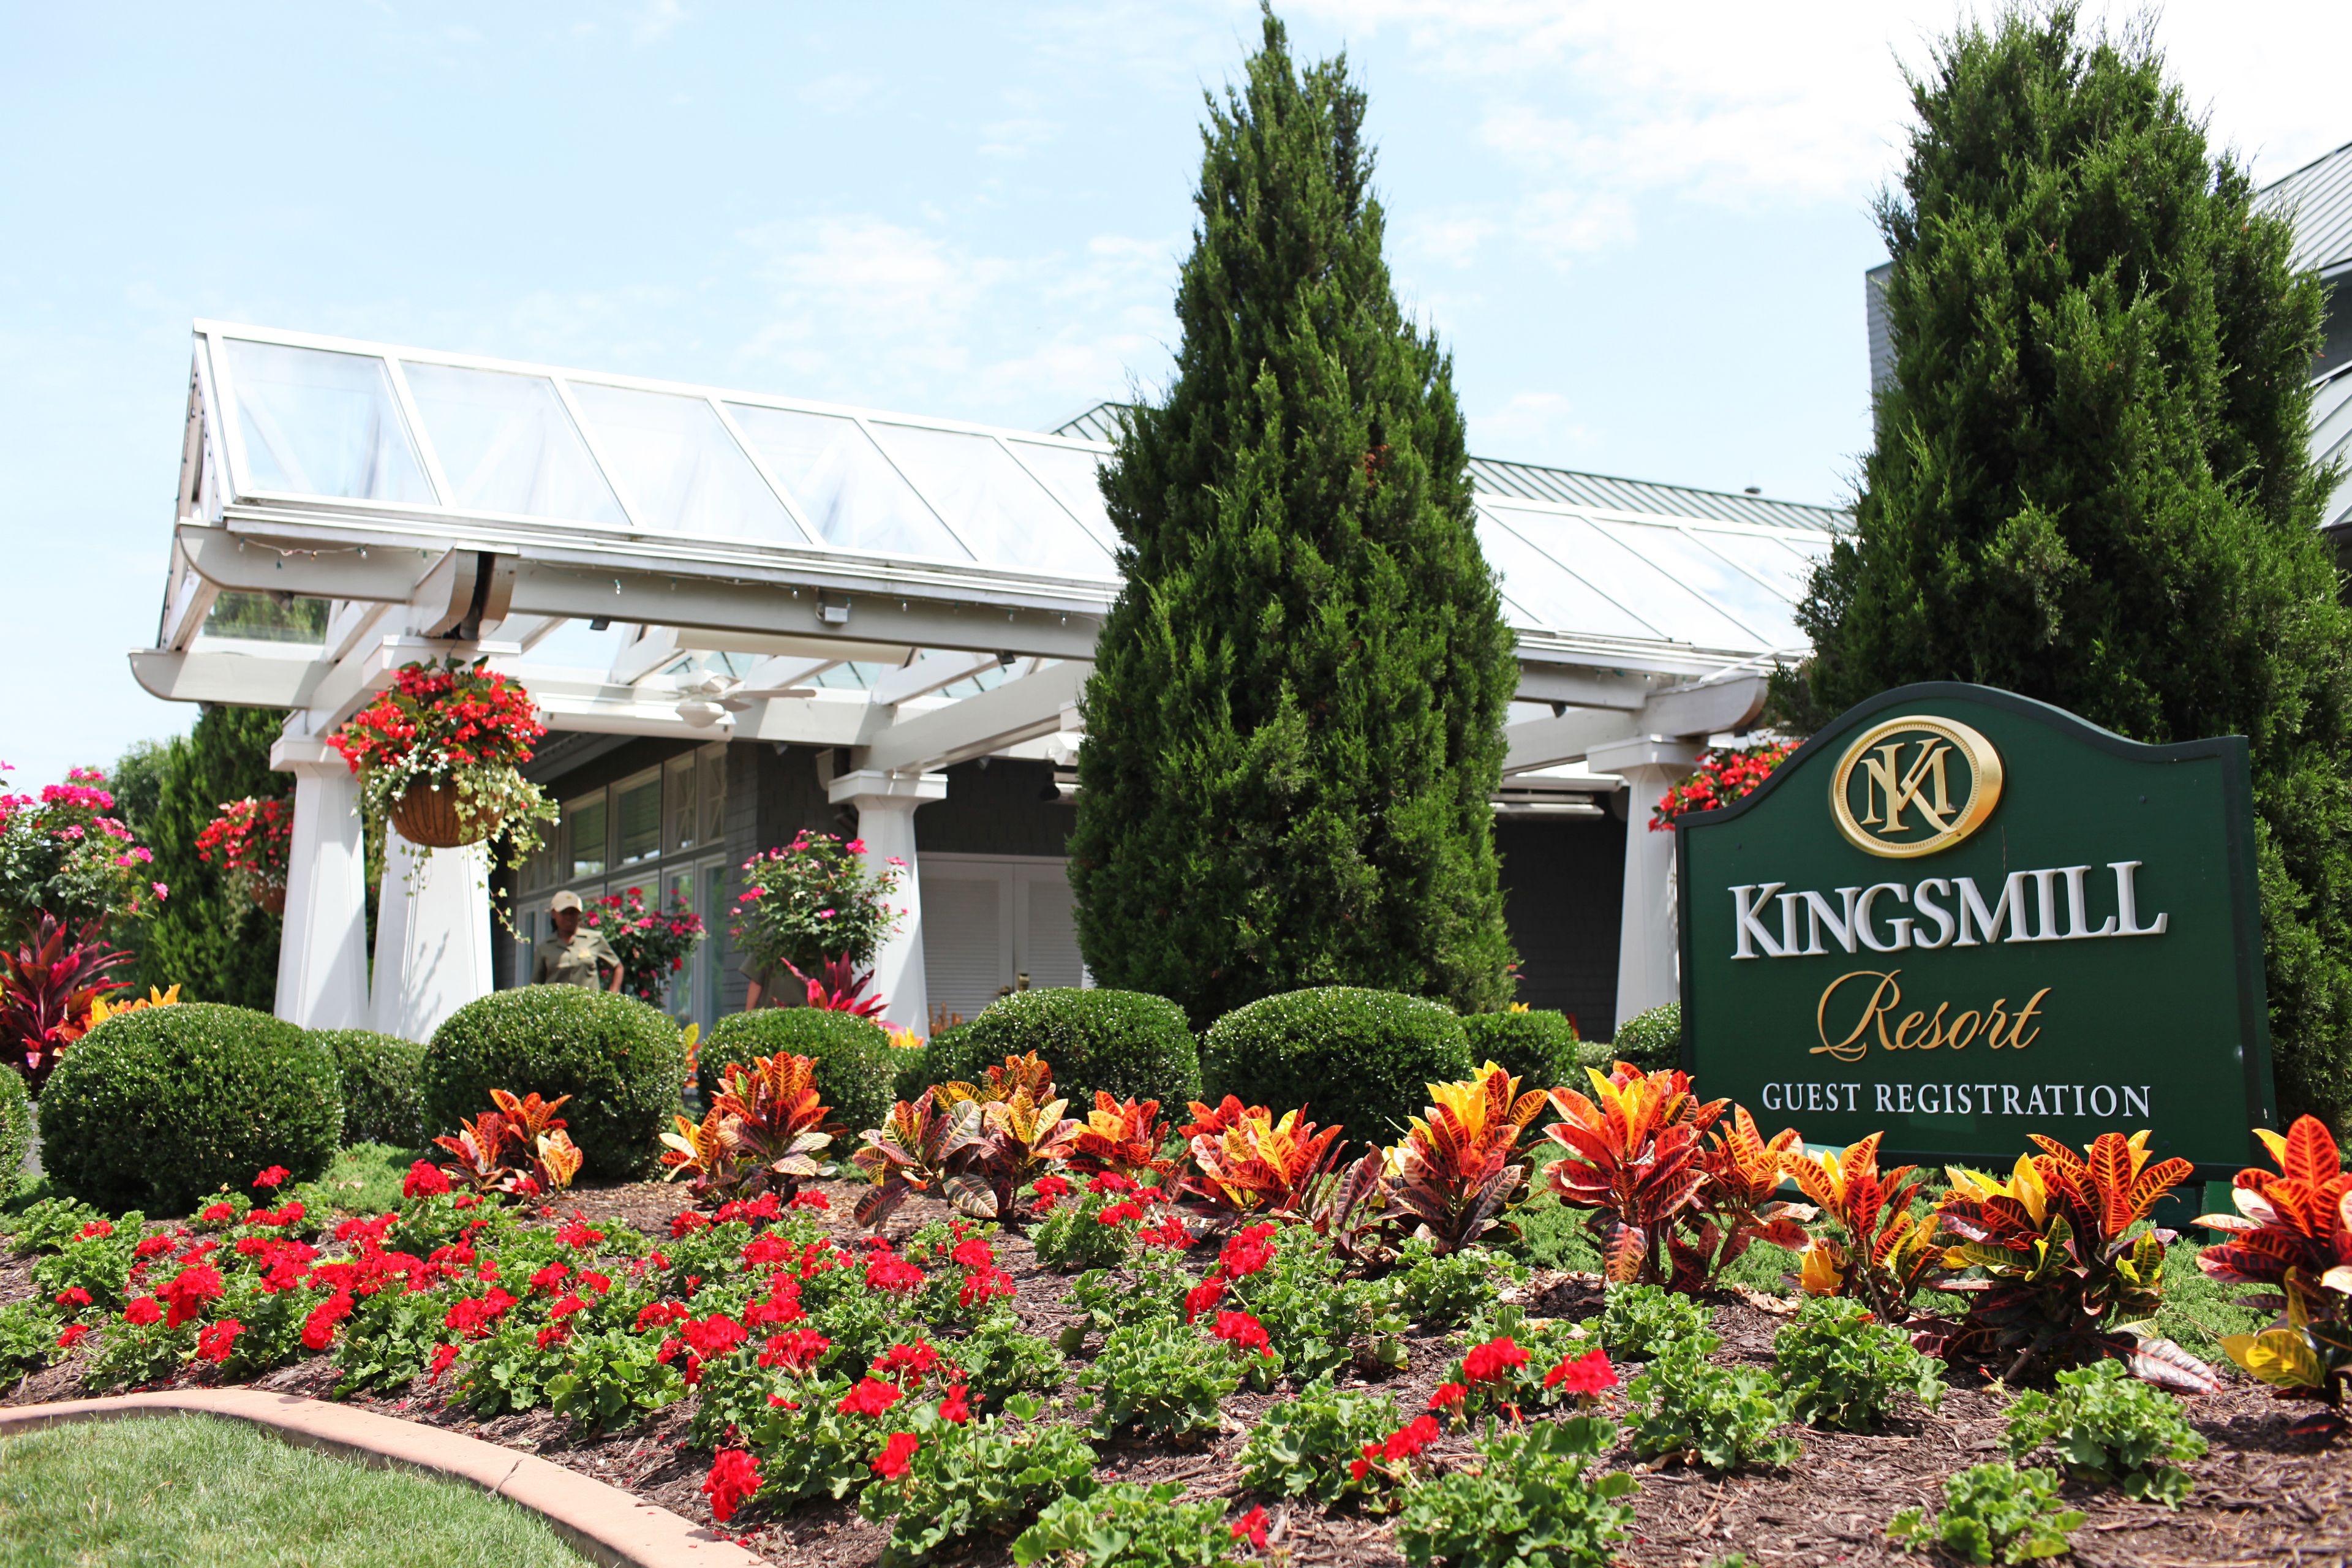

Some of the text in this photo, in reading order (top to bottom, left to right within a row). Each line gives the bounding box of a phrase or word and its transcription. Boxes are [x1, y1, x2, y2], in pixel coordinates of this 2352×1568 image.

[1728, 861, 2167, 959] KINGSMILL
[1809, 970, 2051, 1061] Resort
[1762, 1084, 2150, 1117] GUEST REGISTRATION
